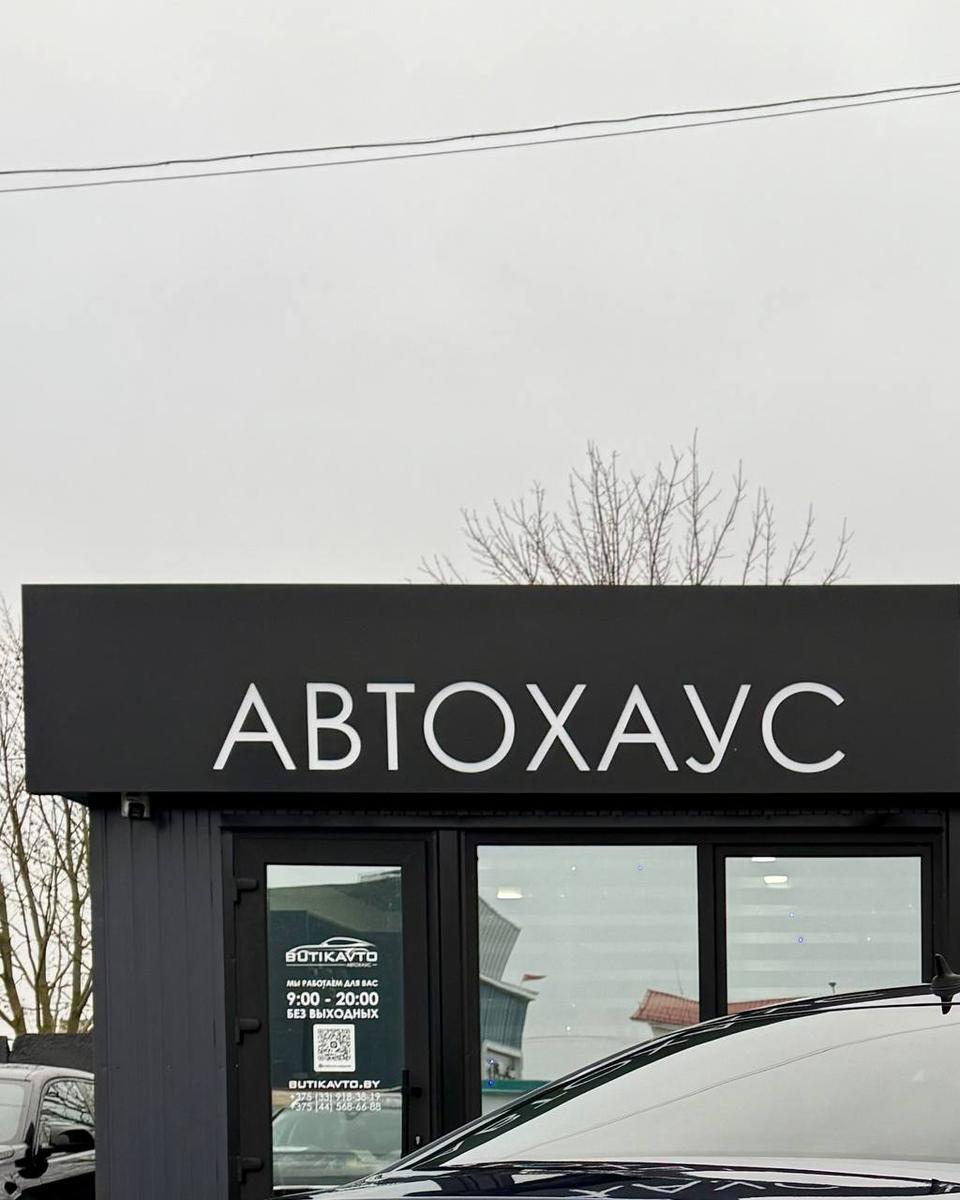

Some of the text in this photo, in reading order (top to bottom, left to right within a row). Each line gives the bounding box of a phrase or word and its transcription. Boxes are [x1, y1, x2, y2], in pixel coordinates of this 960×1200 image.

[213, 681, 845, 773] АВТОХАУС
[285, 951, 378, 963] BUTIKAVTO
[286, 979, 379, 988] МЫ РАБОТАЕМ ДЛЯ ВАС
[286, 991, 321, 1006] 9:00
[335, 991, 379, 1006] 20:00
[286, 1008, 379, 1020] БЕЗ ВЫХОДНЫХ
[288, 1080, 381, 1089] BUTIKAVTO.BY
